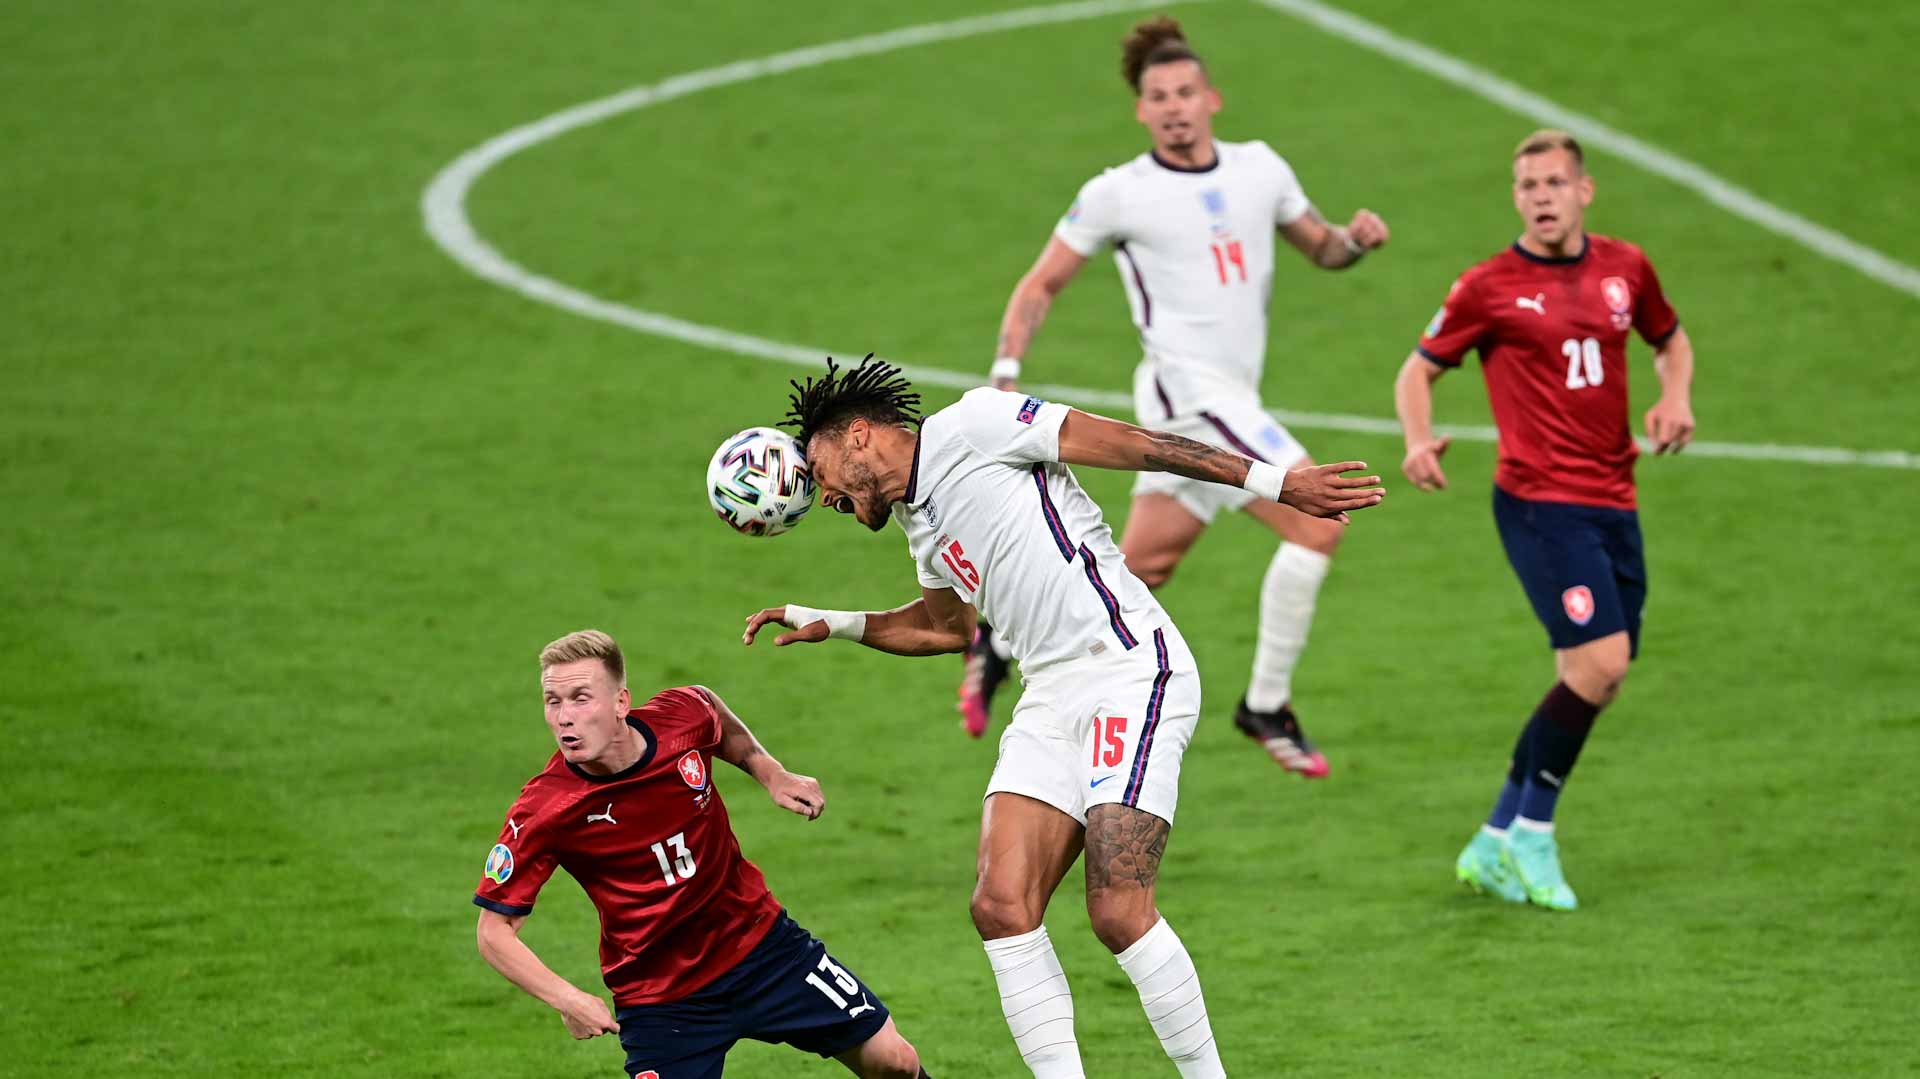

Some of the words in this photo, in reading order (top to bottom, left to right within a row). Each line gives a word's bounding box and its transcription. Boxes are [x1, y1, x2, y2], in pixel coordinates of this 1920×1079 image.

[1210, 241, 1248, 285] 14
[1562, 338, 1604, 390] 20
[941, 540, 980, 593] 15
[1092, 716, 1128, 768] 15
[651, 832, 697, 887] 13
[805, 953, 859, 1010] 13
